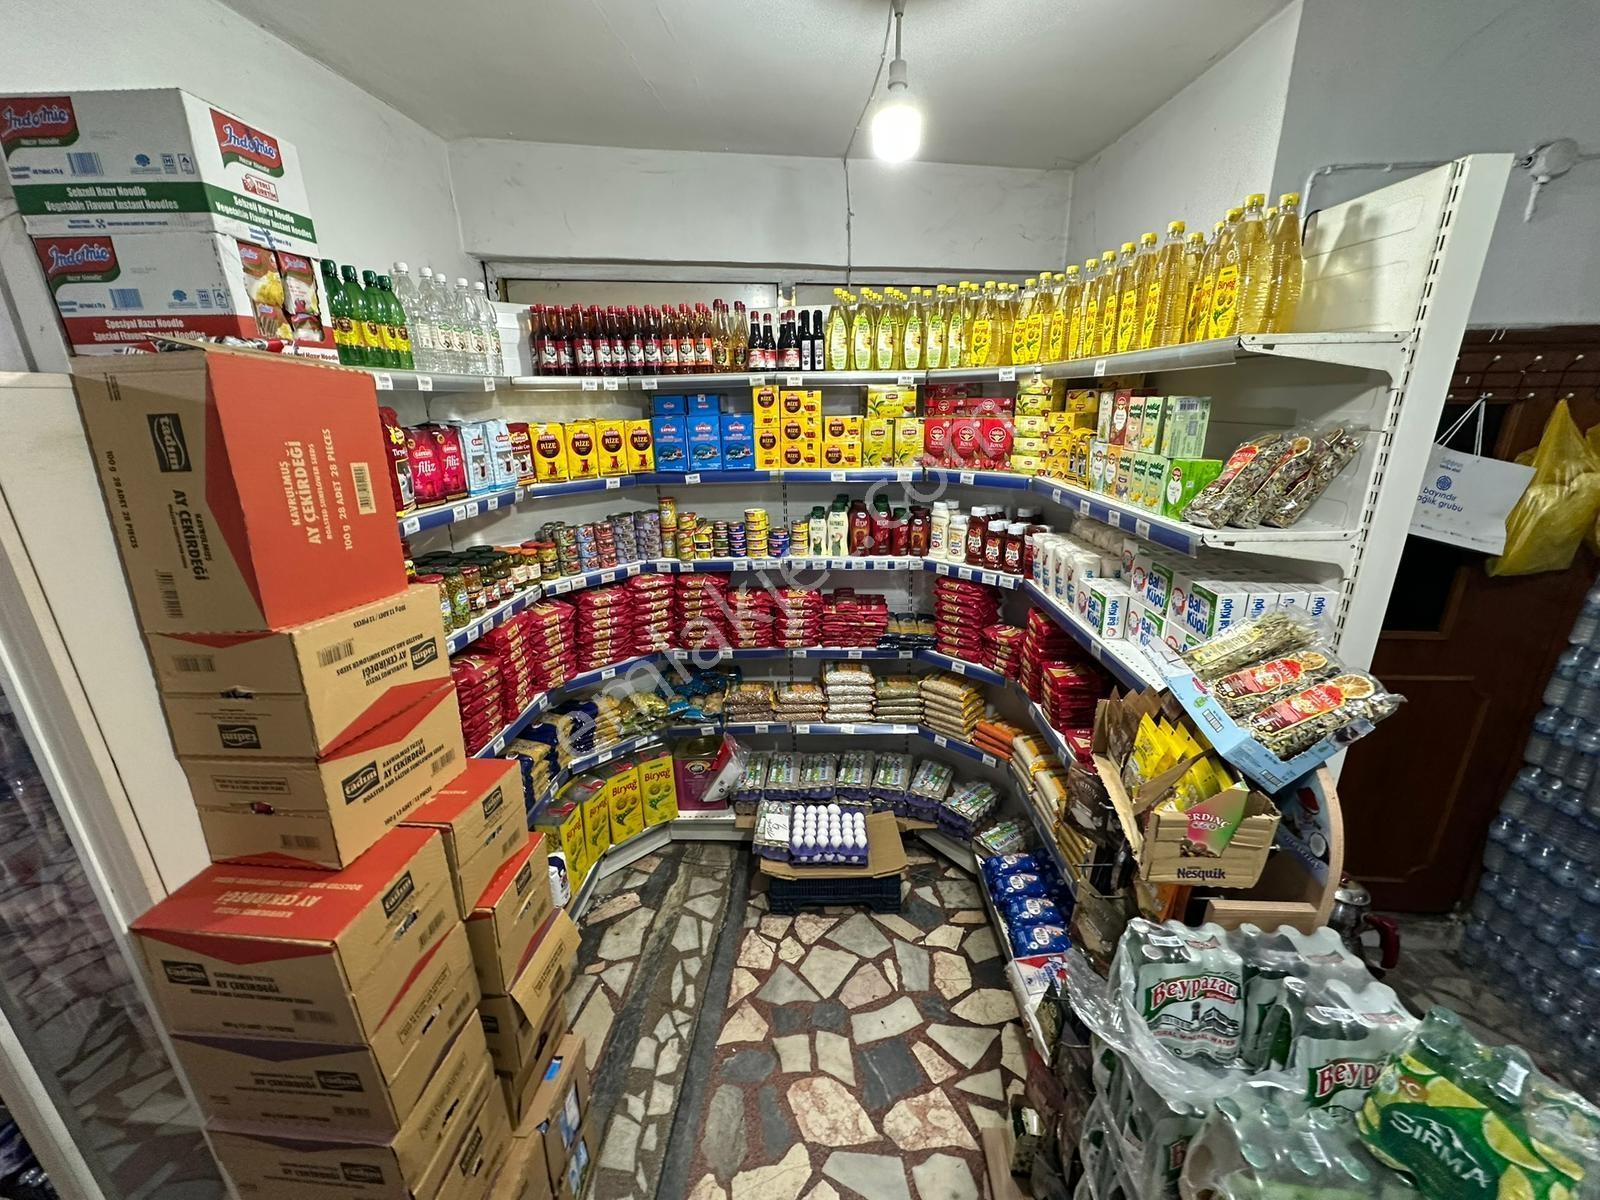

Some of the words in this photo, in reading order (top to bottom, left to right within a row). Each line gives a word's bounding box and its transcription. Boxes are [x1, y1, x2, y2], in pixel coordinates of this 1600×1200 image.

[2, 104, 69, 137] Indomie
[222, 123, 276, 159] Indomie
[118, 186, 147, 196] Noodle
[145, 199, 179, 210] Noodles
[48, 244, 110, 273] Indomie
[157, 319, 184, 328] Noodle
[322, 428, 336, 462] PIECES
[330, 463, 340, 478] 28
[417, 460, 436, 477] filiz
[445, 454, 460, 470] filiz
[285, 441, 320, 525] ÇEKİRDEĞİ
[172, 489, 189, 508] AY
[278, 461, 302, 527] KAVRULMUŞ
[335, 480, 346, 506] ADET
[1423, 487, 1457, 501] bayındır
[339, 507, 348, 520] 28
[1438, 500, 1463, 512] grubu
[306, 525, 322, 545] AY
[345, 532, 353, 550] 100
[1148, 572, 1160, 589] Bal
[1147, 586, 1164, 608] Küpü
[1188, 593, 1201, 614] Bal
[1221, 599, 1234, 618] Küpü
[1187, 610, 1207, 635] Küpü
[644, 768, 670, 781] Biryağ
[612, 779, 638, 796] Biryağ
[1177, 868, 1225, 881] Nesquik
[1390, 1110, 1491, 1188] SIRMA
